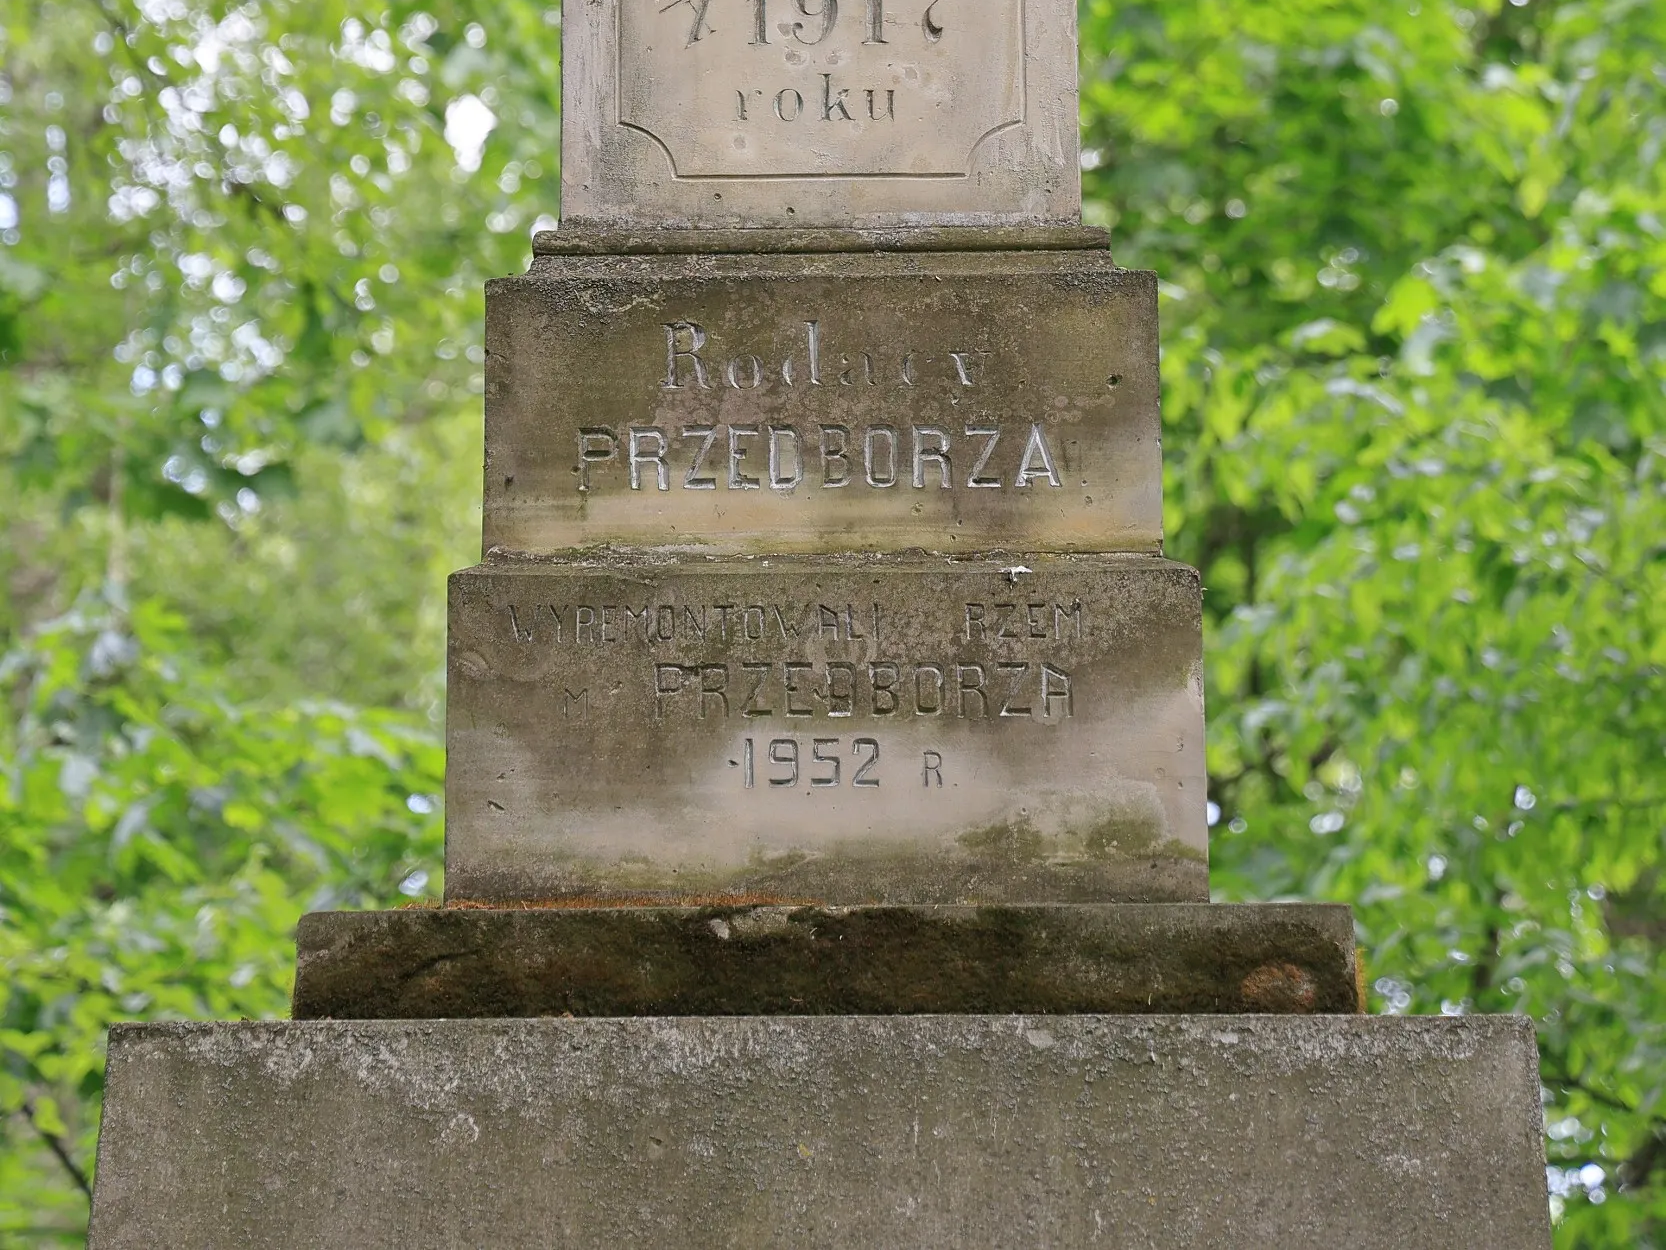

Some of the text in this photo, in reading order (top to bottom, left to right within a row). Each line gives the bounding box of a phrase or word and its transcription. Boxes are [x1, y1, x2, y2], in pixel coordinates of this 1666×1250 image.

[733, 72, 896, 123] roku
[576, 422, 1062, 493] PRZEDBORZA
[506, 599, 1083, 645] WYREMONTOWALI RZEM
[653, 659, 1075, 720] PRZEDBORZA
[743, 736, 944, 790] 1952 R
